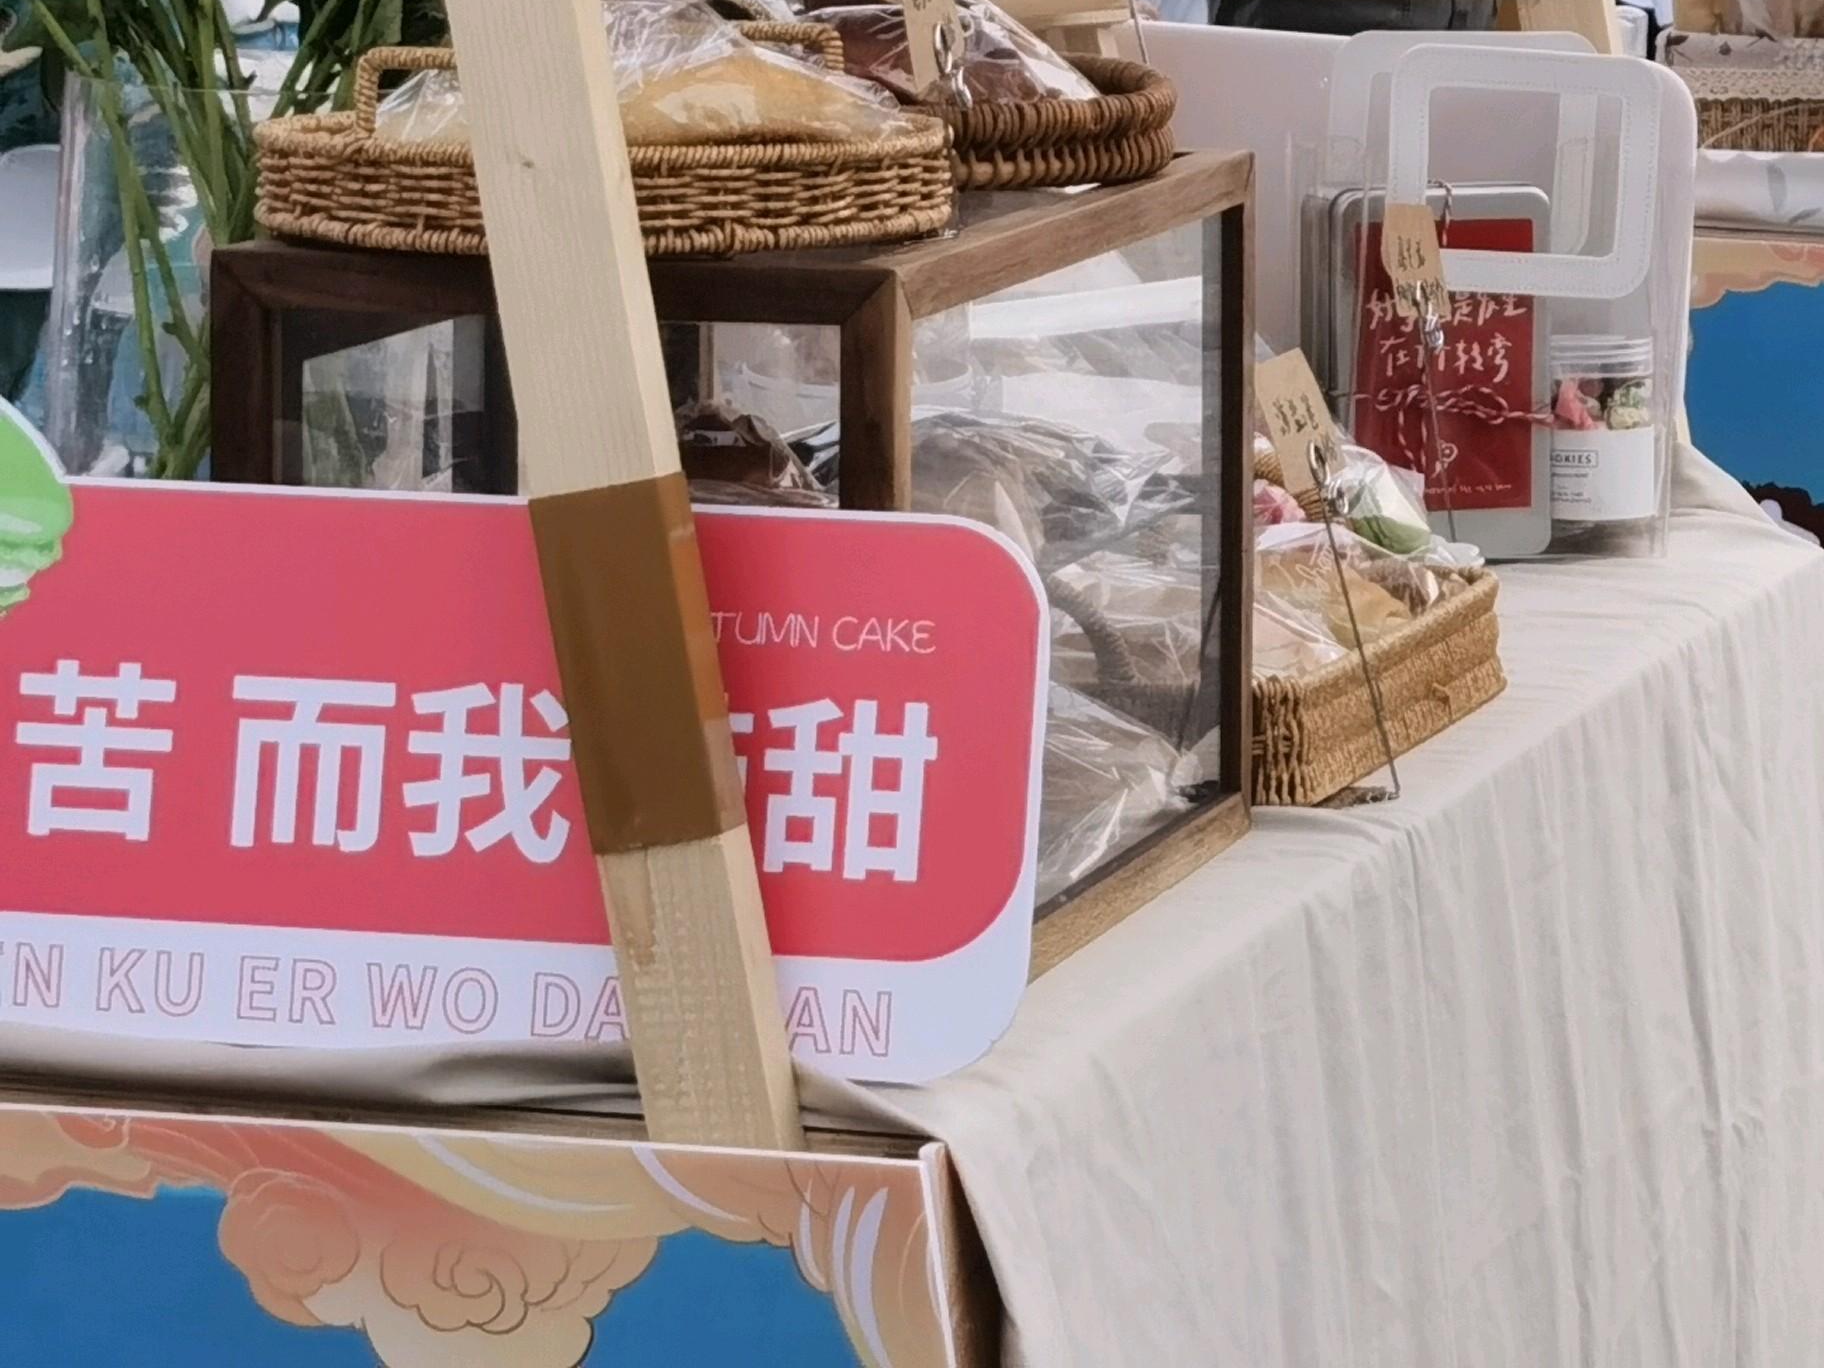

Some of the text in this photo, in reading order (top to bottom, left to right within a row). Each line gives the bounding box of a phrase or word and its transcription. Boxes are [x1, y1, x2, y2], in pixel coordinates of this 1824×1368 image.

[1550, 453, 1592, 464] OKIES
[711, 611, 937, 654] TUMN CAKE
[230, 675, 938, 882] 而我甜
[0, 940, 64, 1009] N
[96, 946, 204, 1018] KU
[236, 955, 337, 1025] ER
[366, 962, 499, 1034] WO
